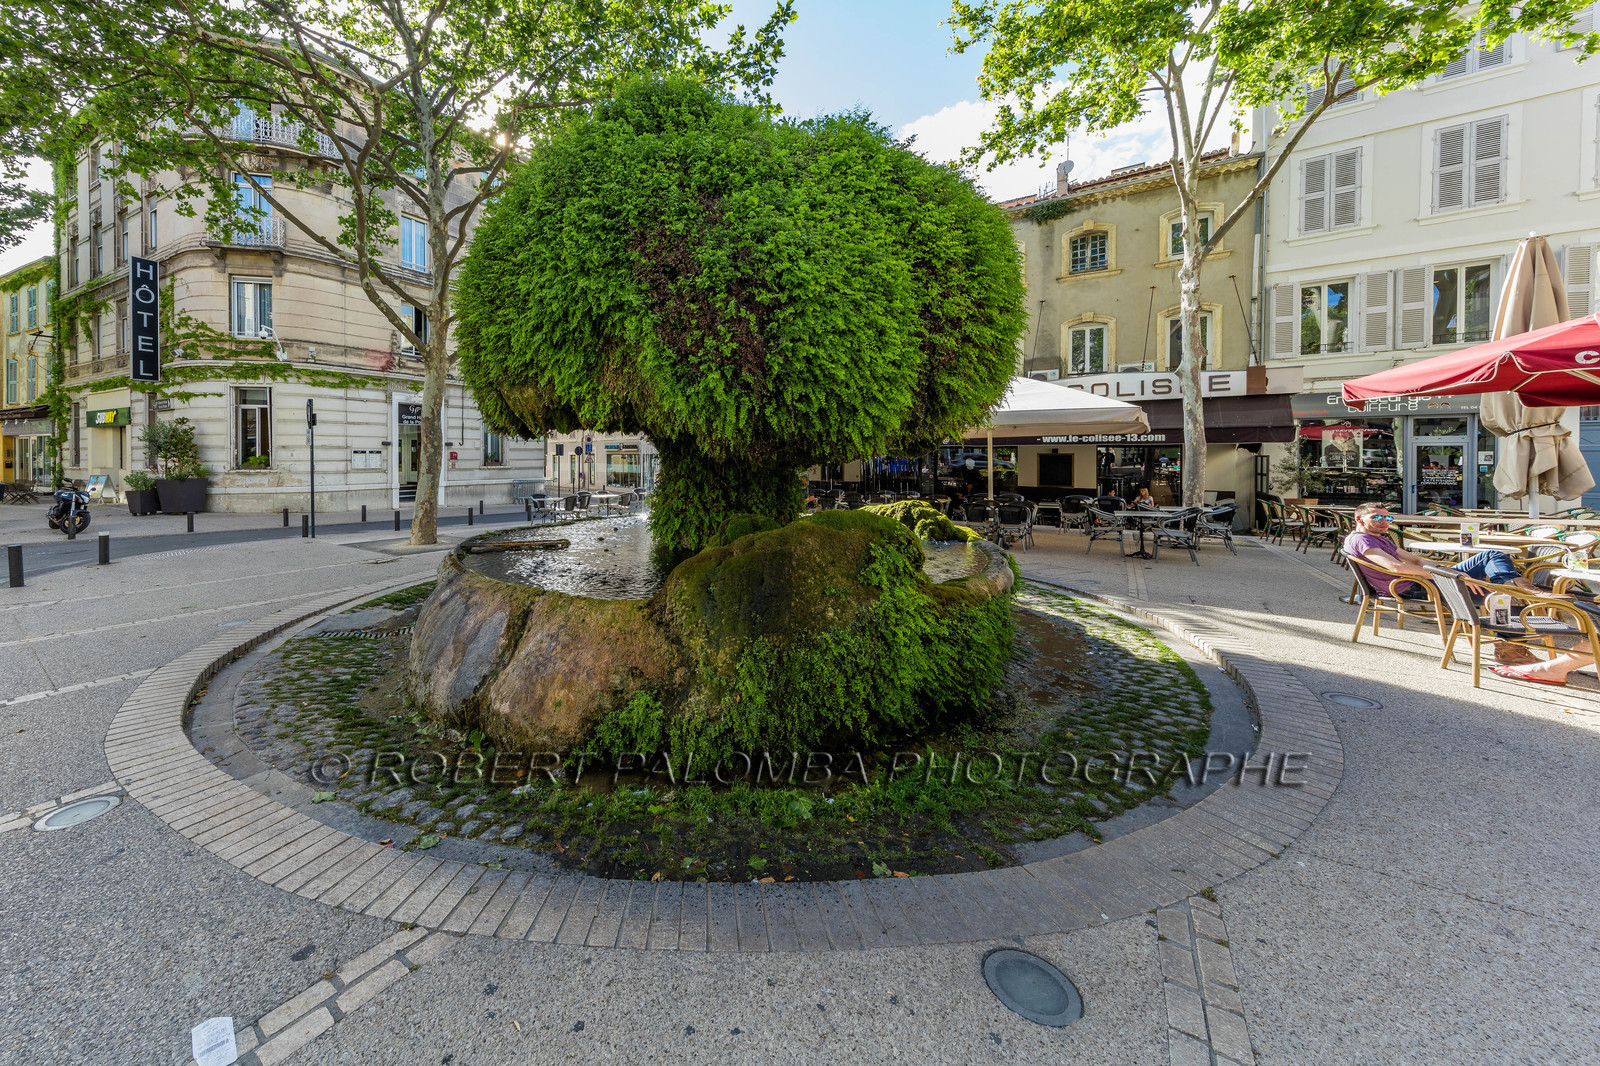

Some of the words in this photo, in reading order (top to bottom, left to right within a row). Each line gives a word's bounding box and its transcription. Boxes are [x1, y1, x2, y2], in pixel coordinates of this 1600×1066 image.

[135, 262, 155, 376] HÔTEL
[1067, 374, 1231, 397] OLISE
[96, 410, 117, 424] SUBWAY
[1042, 433, 1165, 443] www.le-colisee-13.com
